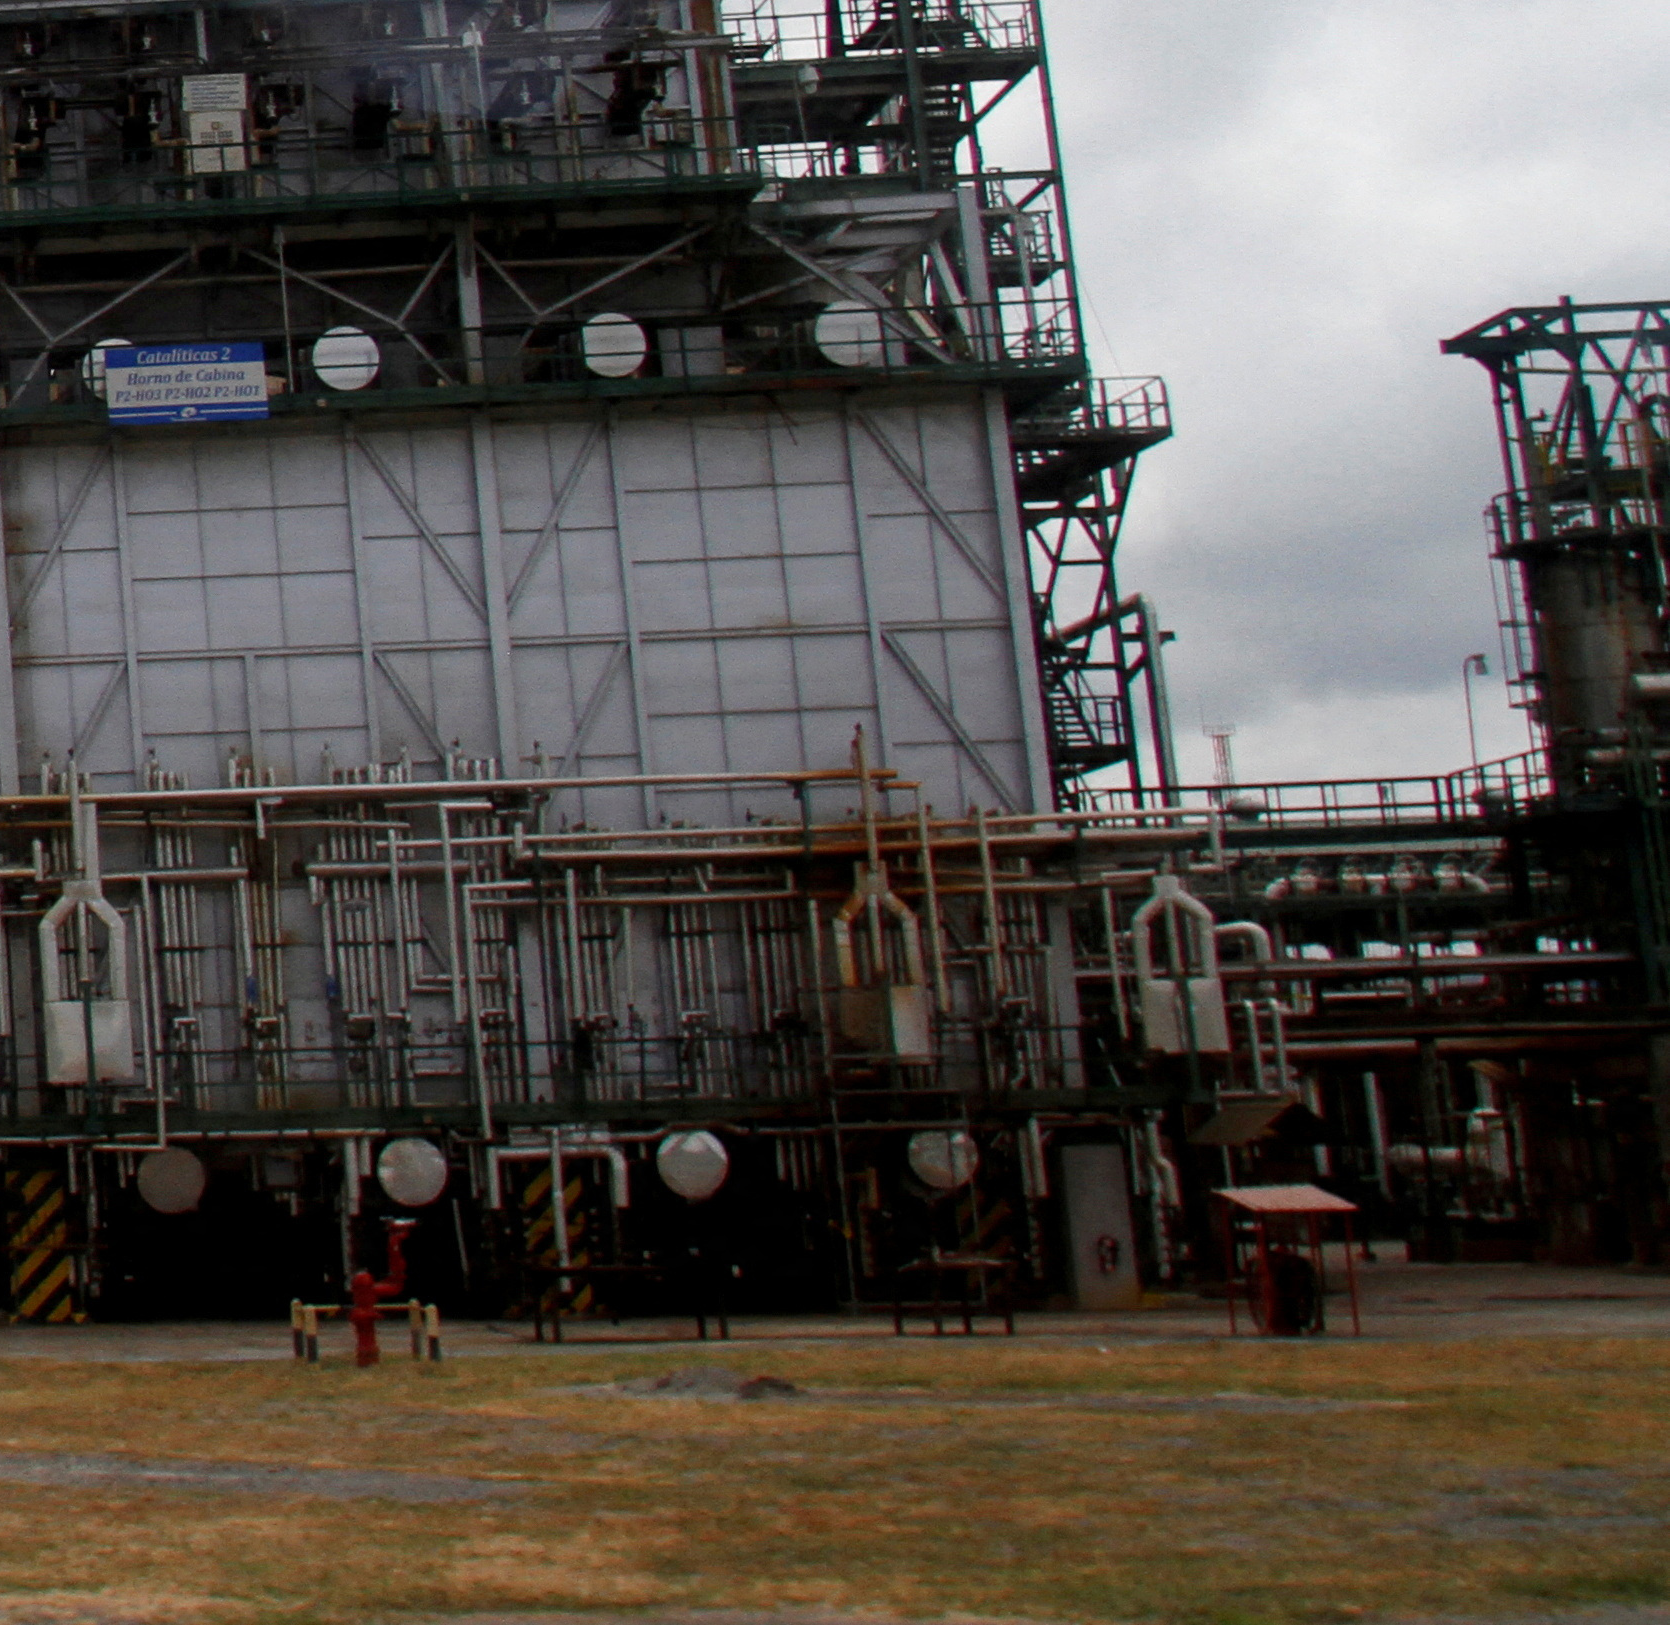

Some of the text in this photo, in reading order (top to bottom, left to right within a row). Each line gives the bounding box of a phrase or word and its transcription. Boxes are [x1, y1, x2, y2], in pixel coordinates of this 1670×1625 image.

[137, 347, 232, 364] Catalíticas 2
[127, 368, 245, 386] Horno de Cabina
